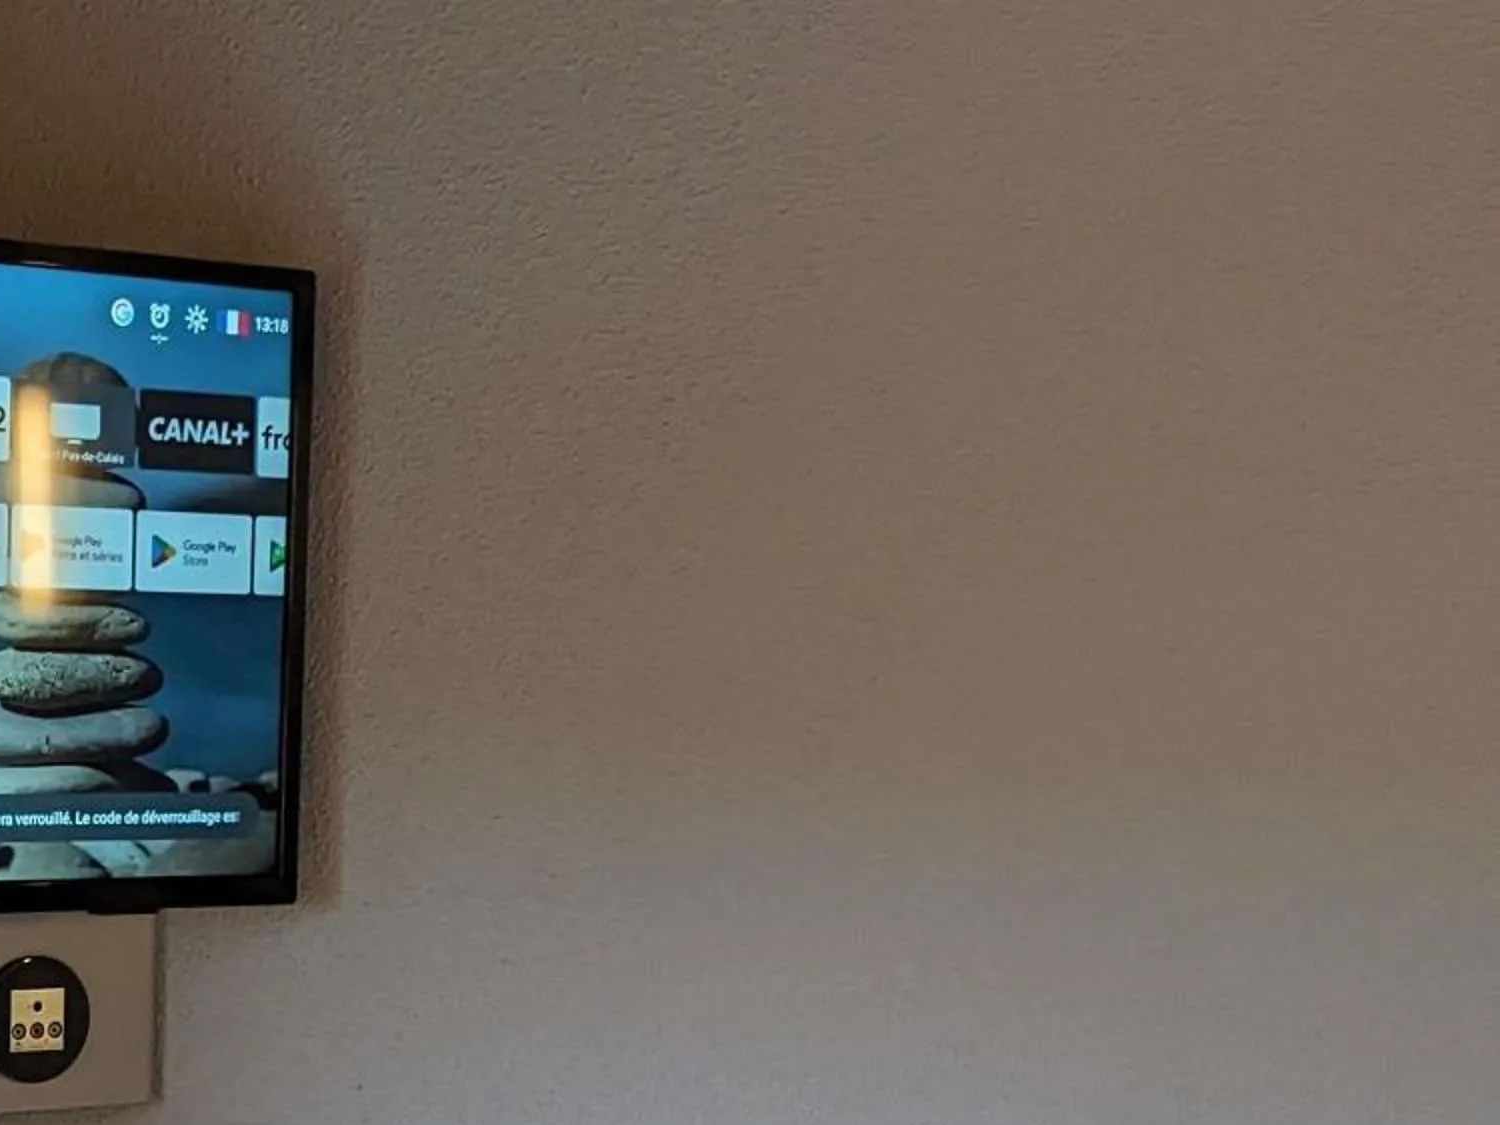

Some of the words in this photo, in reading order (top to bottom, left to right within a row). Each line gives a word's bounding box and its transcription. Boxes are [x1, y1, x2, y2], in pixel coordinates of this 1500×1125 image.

[148, 416, 250, 446] CANAL+
[182, 539, 215, 555] Google
[217, 540, 237, 556] Play
[75, 811, 90, 825] Le
[92, 810, 122, 824] code
[124, 810, 139, 824] de
[141, 808, 220, 826] déverrouillage
